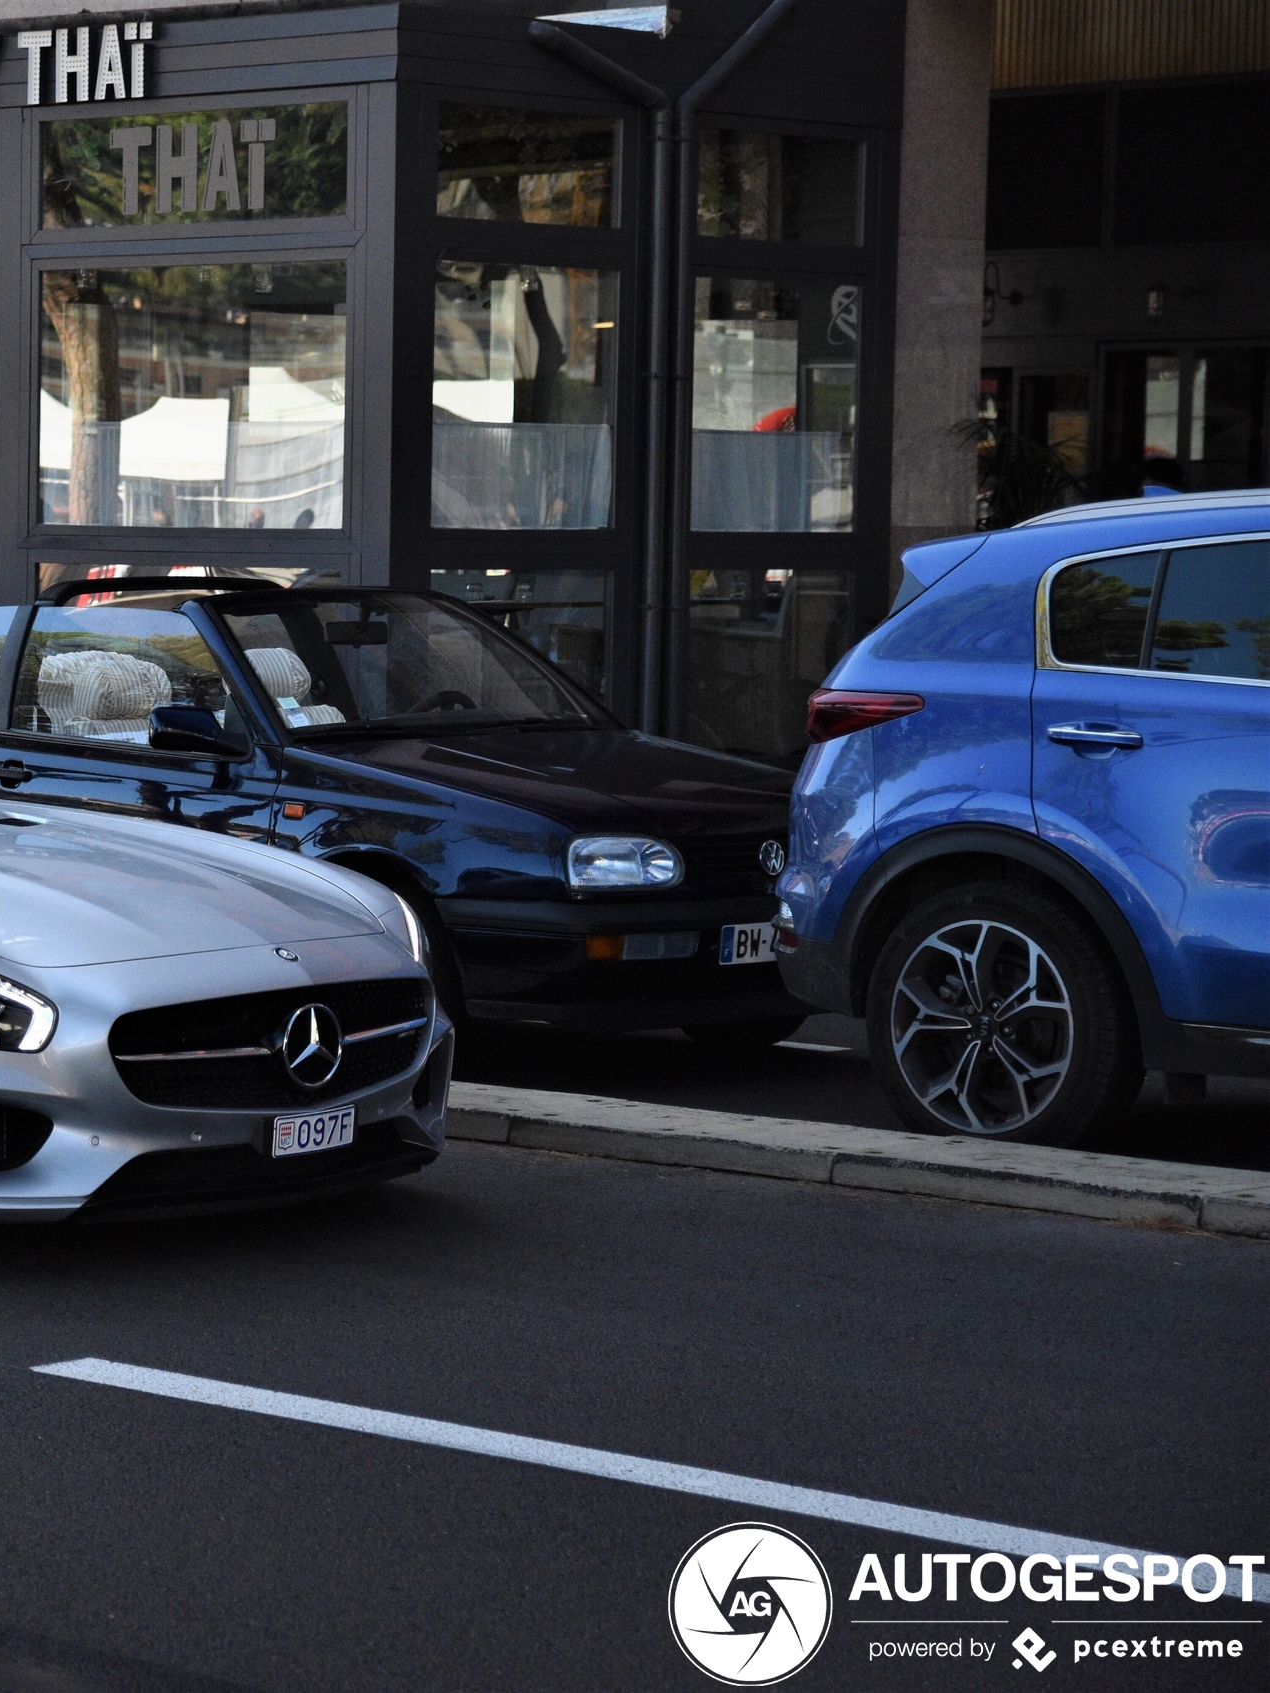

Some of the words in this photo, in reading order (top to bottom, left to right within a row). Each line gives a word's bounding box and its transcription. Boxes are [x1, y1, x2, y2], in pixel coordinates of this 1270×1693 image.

[17, 21, 154, 106] THAÏ
[110, 117, 276, 216] THAÏ
[297, 1111, 352, 1149] 097F
